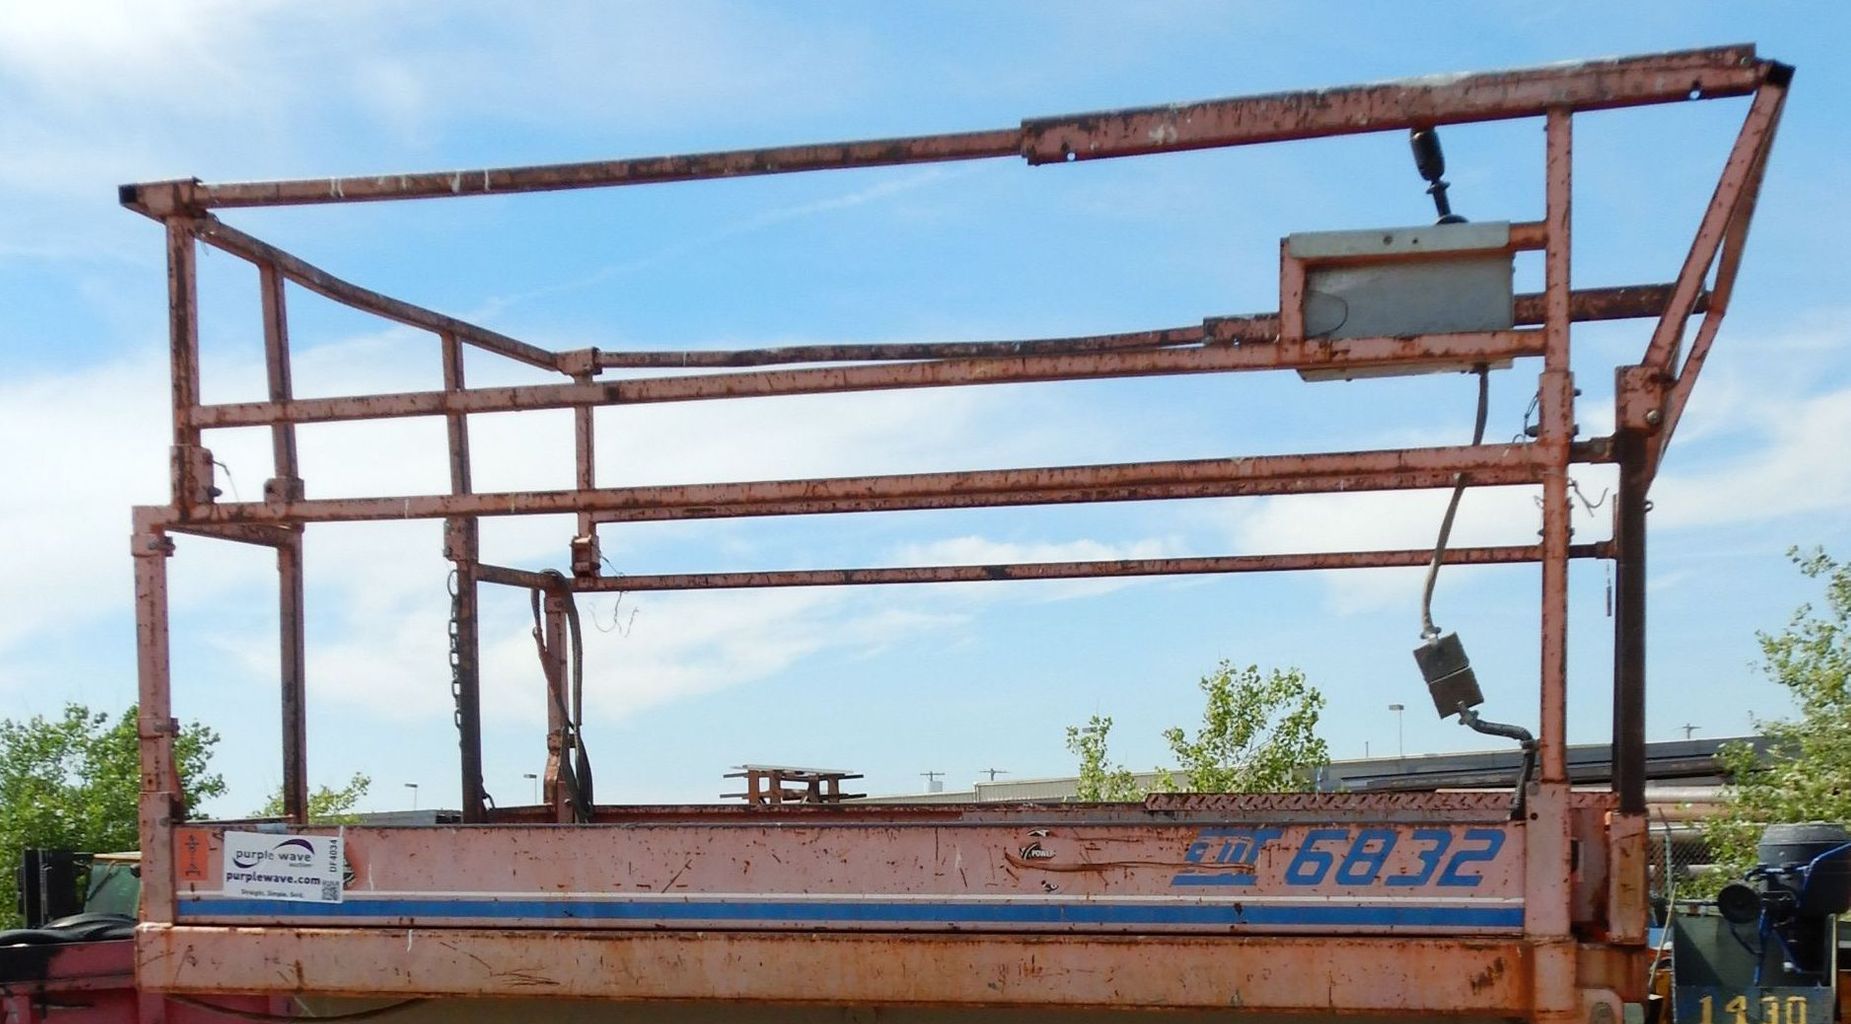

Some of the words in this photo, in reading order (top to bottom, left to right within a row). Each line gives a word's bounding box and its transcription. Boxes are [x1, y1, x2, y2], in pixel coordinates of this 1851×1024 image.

[236, 849, 275, 862] purple
[278, 852, 312, 863] wave
[329, 839, 338, 872] DF4034
[1285, 829, 1506, 886] 6832
[226, 871, 321, 885] purplewave.com
